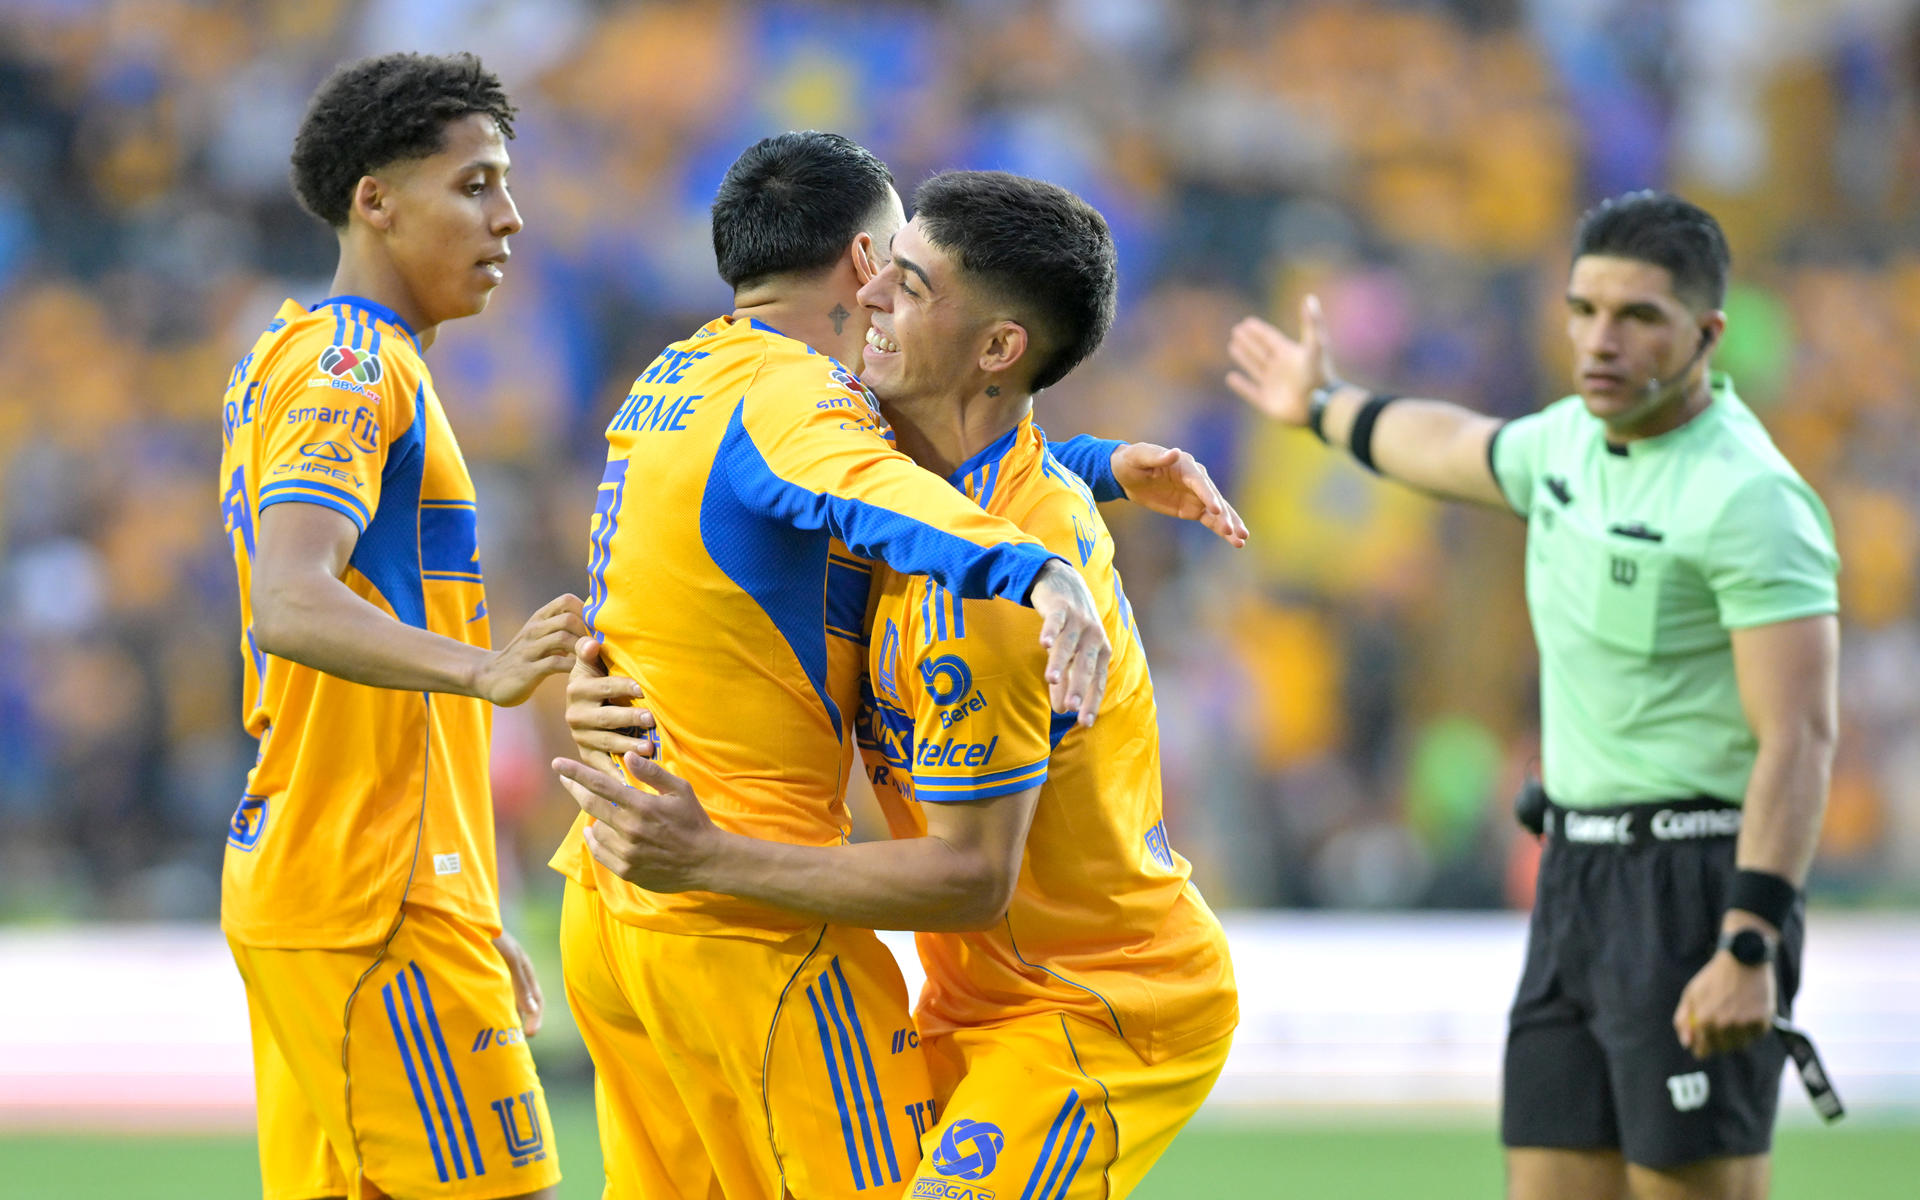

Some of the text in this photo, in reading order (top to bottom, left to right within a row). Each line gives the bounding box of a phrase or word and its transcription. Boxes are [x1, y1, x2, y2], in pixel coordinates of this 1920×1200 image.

[332, 379, 366, 396] BBVA
[287, 406, 351, 425] smart
[350, 405, 381, 448] fit
[272, 462, 365, 489] CHIREY
[939, 689, 988, 730] Berel
[916, 735, 999, 767] telcel
